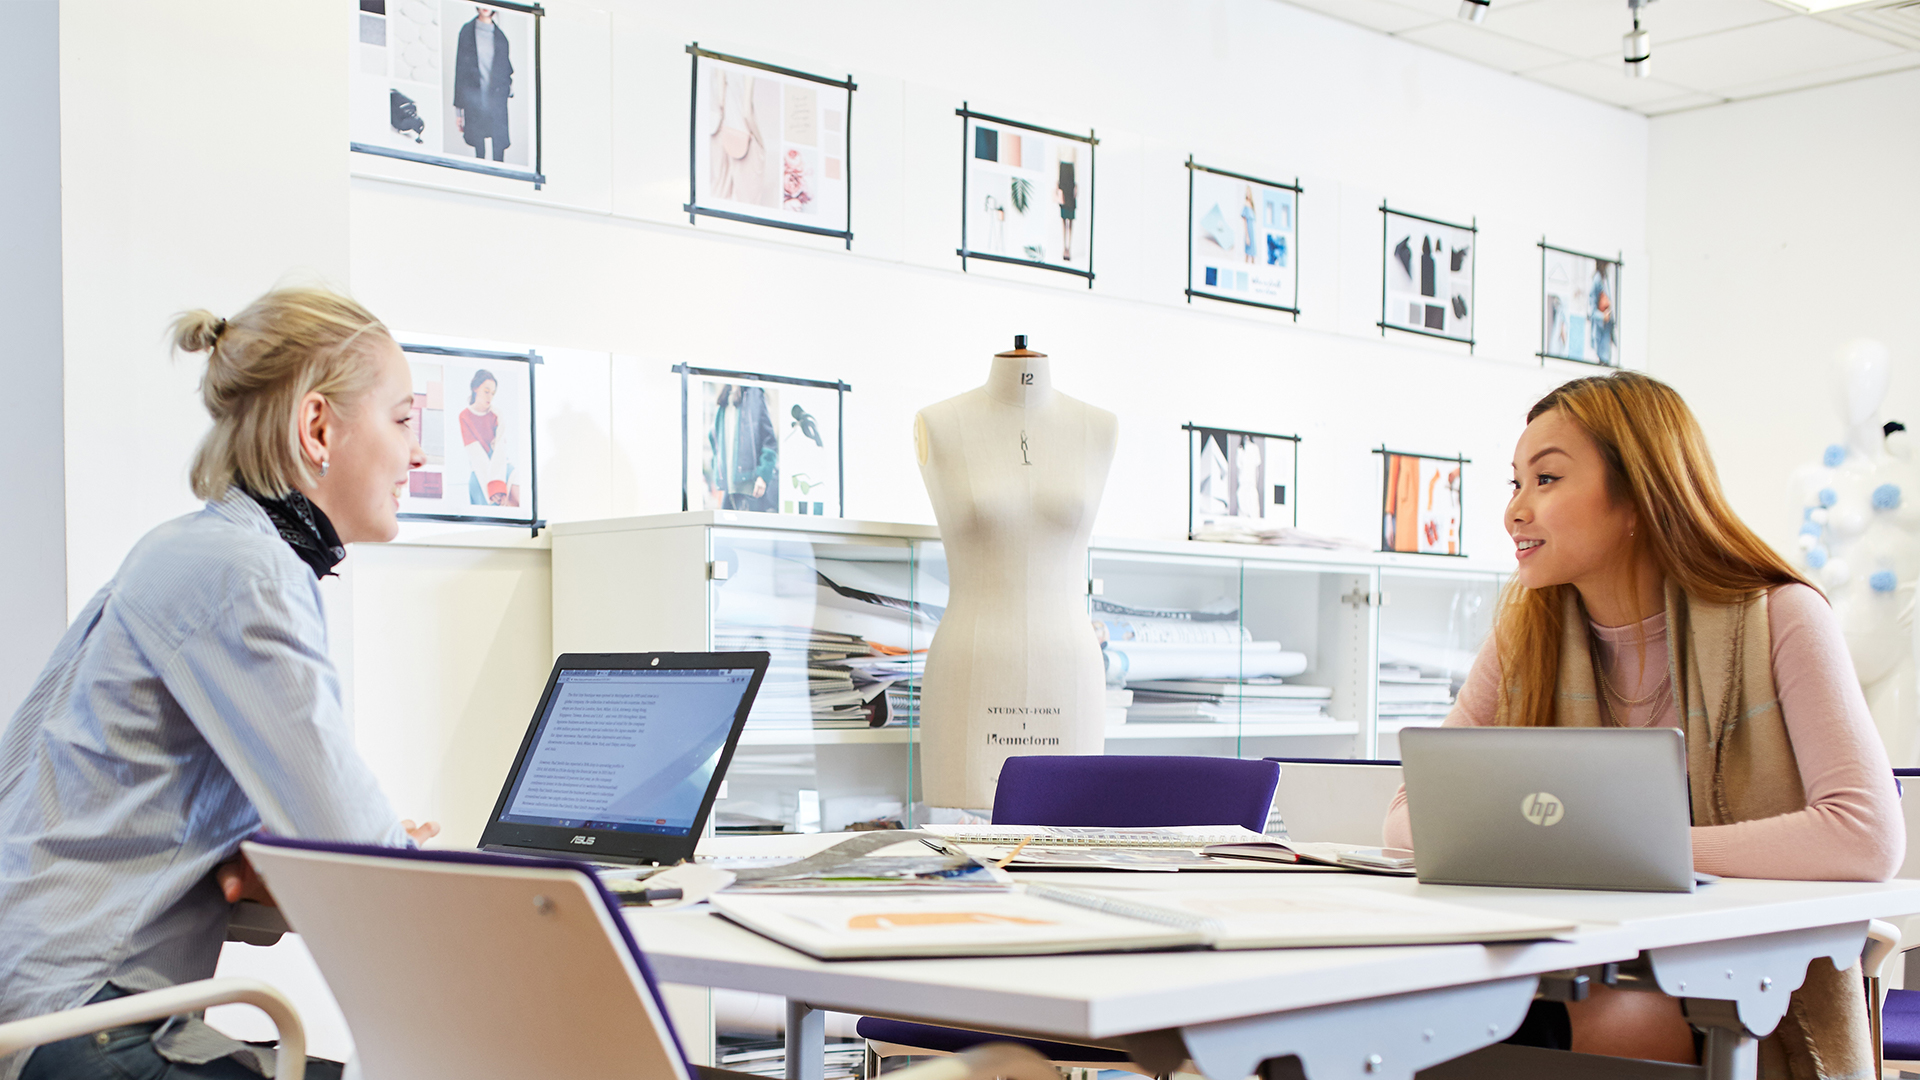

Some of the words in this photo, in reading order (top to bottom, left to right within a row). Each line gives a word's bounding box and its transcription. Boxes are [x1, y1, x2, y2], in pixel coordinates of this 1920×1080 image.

[1021, 372, 1034, 385] 12
[988, 707, 1060, 715] STUDENT-FORM
[1529, 793, 1558, 826] hp
[570, 835, 596, 846] ASUS
